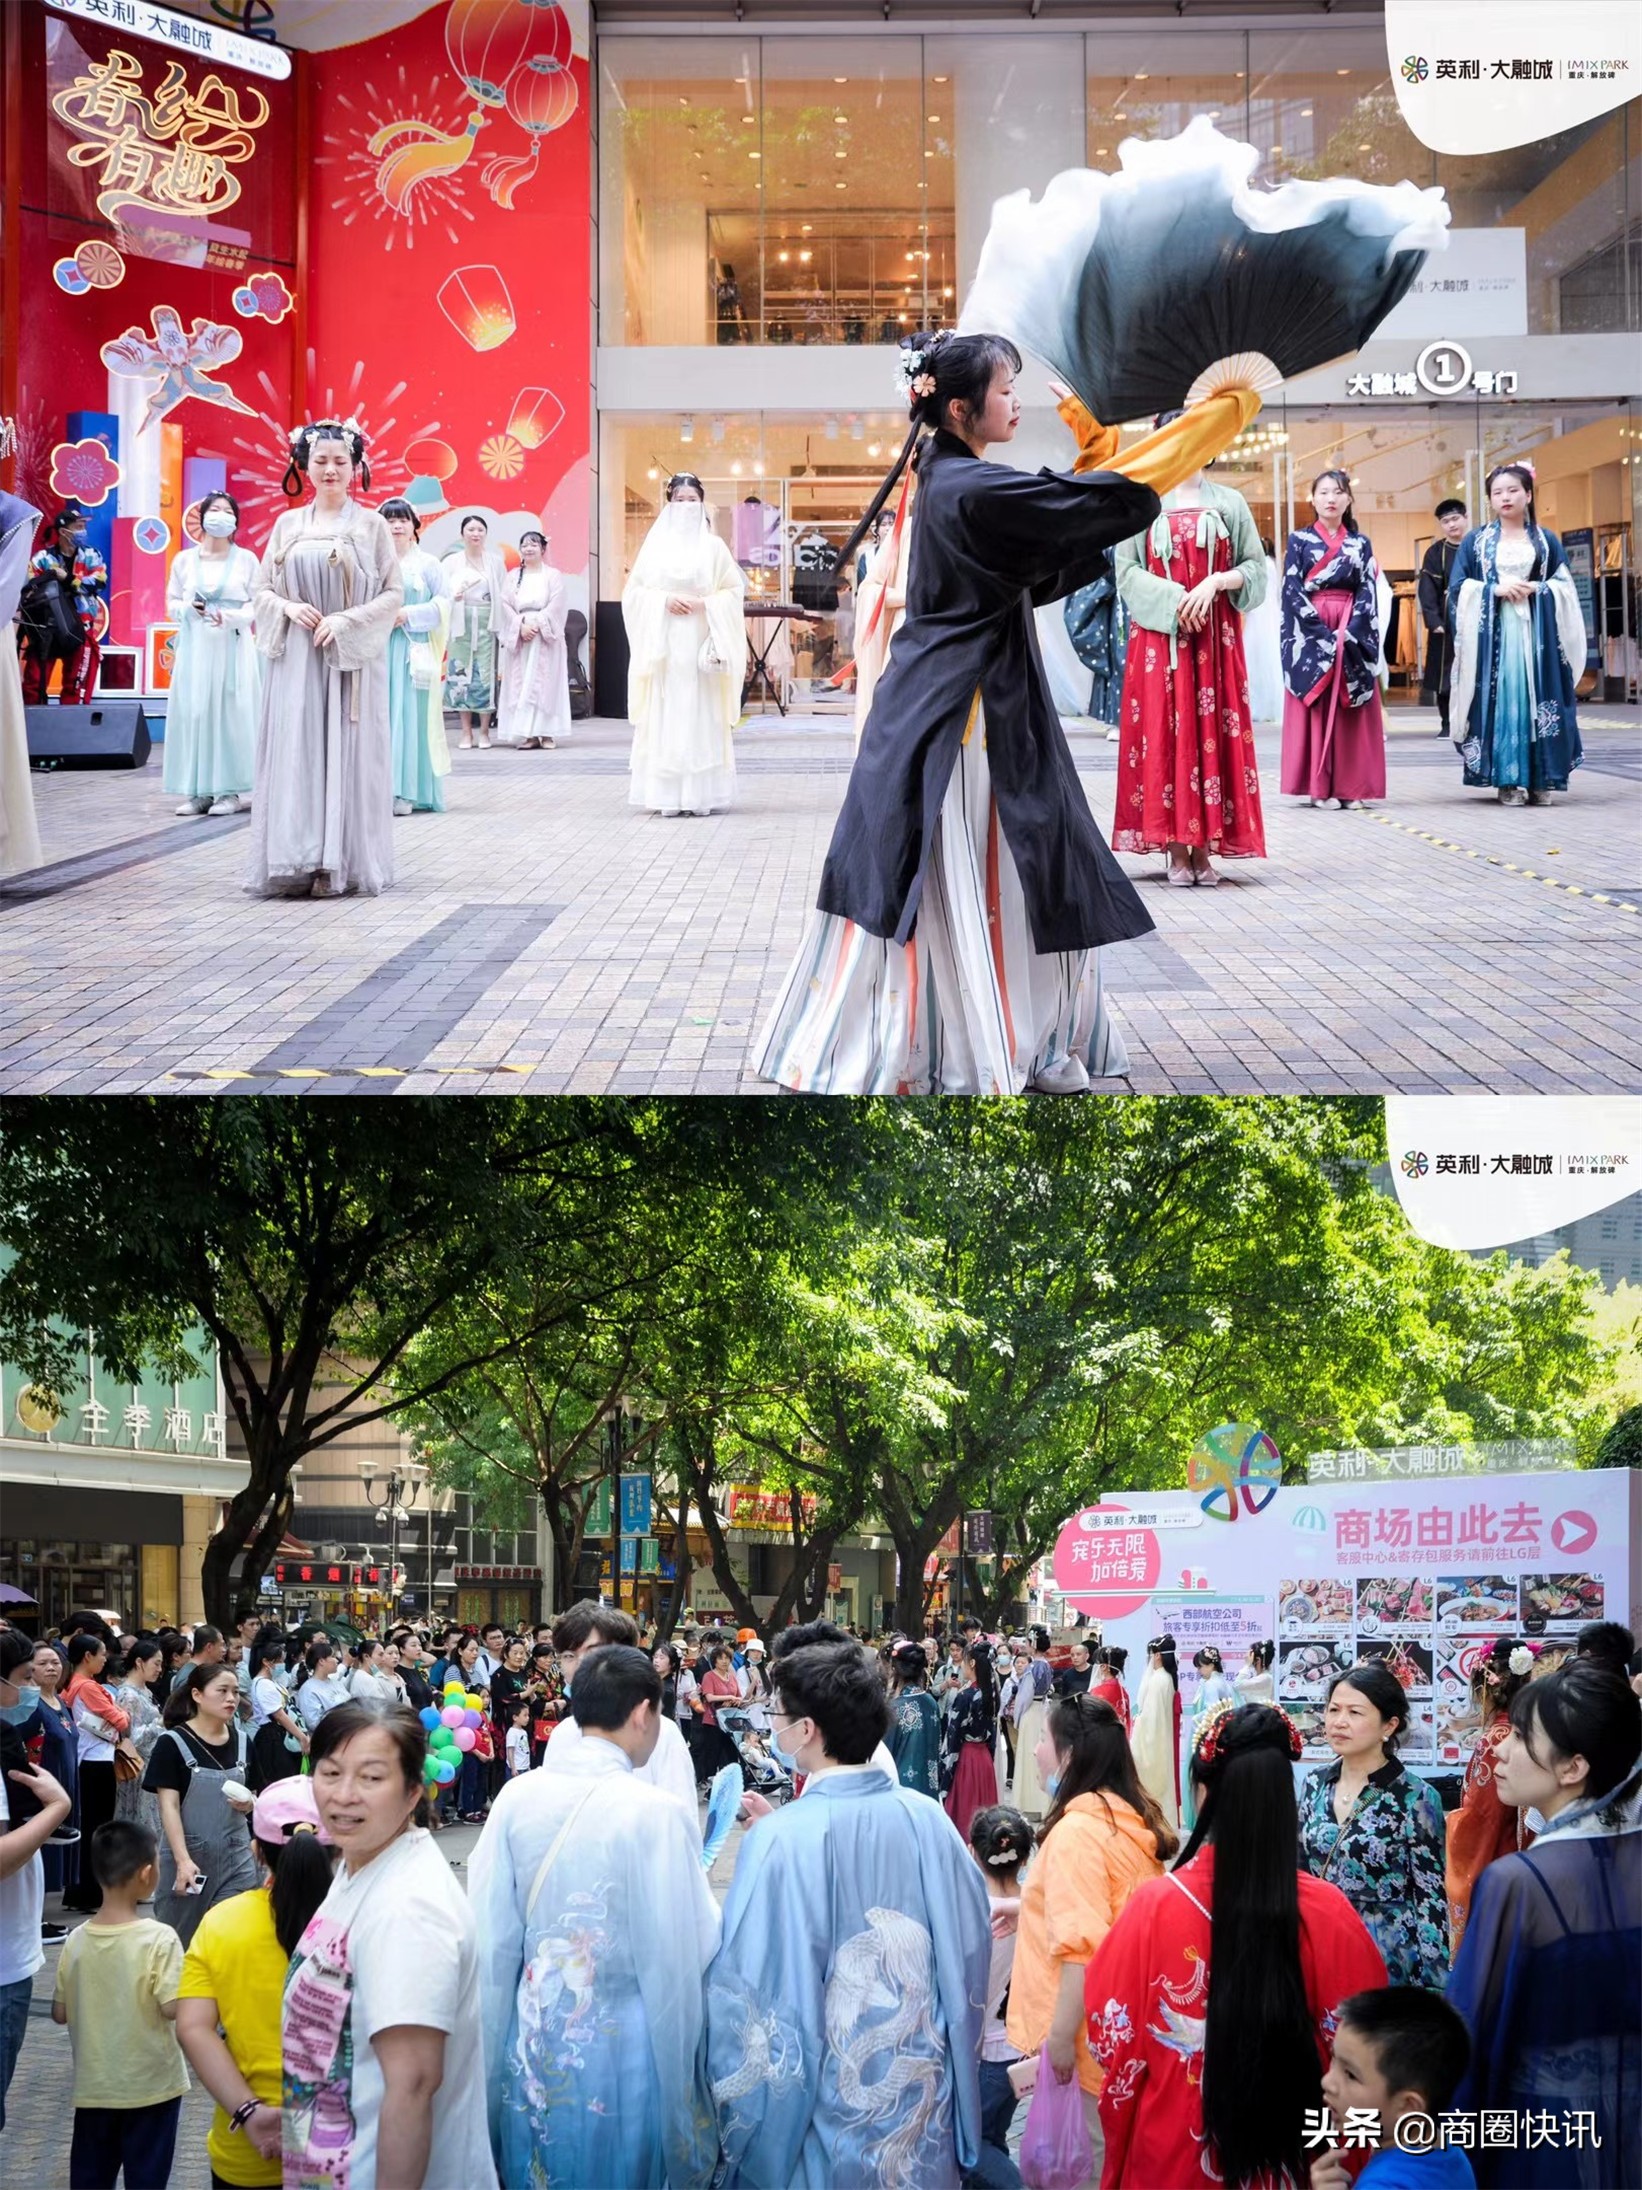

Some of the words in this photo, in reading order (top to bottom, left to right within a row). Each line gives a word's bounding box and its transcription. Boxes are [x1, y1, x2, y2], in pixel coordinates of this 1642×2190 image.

[1348, 372, 1418, 396] 大融城
[1435, 354, 1455, 382] 1
[1472, 370, 1518, 394] 号门
[79, 1398, 228, 1444] 全季酒店
[1334, 1501, 1543, 1549] 商场由此去
[1071, 1533, 1147, 1564] 宠乐无限
[1335, 1546, 1542, 1565] 客服中心&寄存包服务请前往LG层
[1090, 1557, 1147, 1583] 加倍爱
[1183, 1608, 1242, 1620] 西部航空公司
